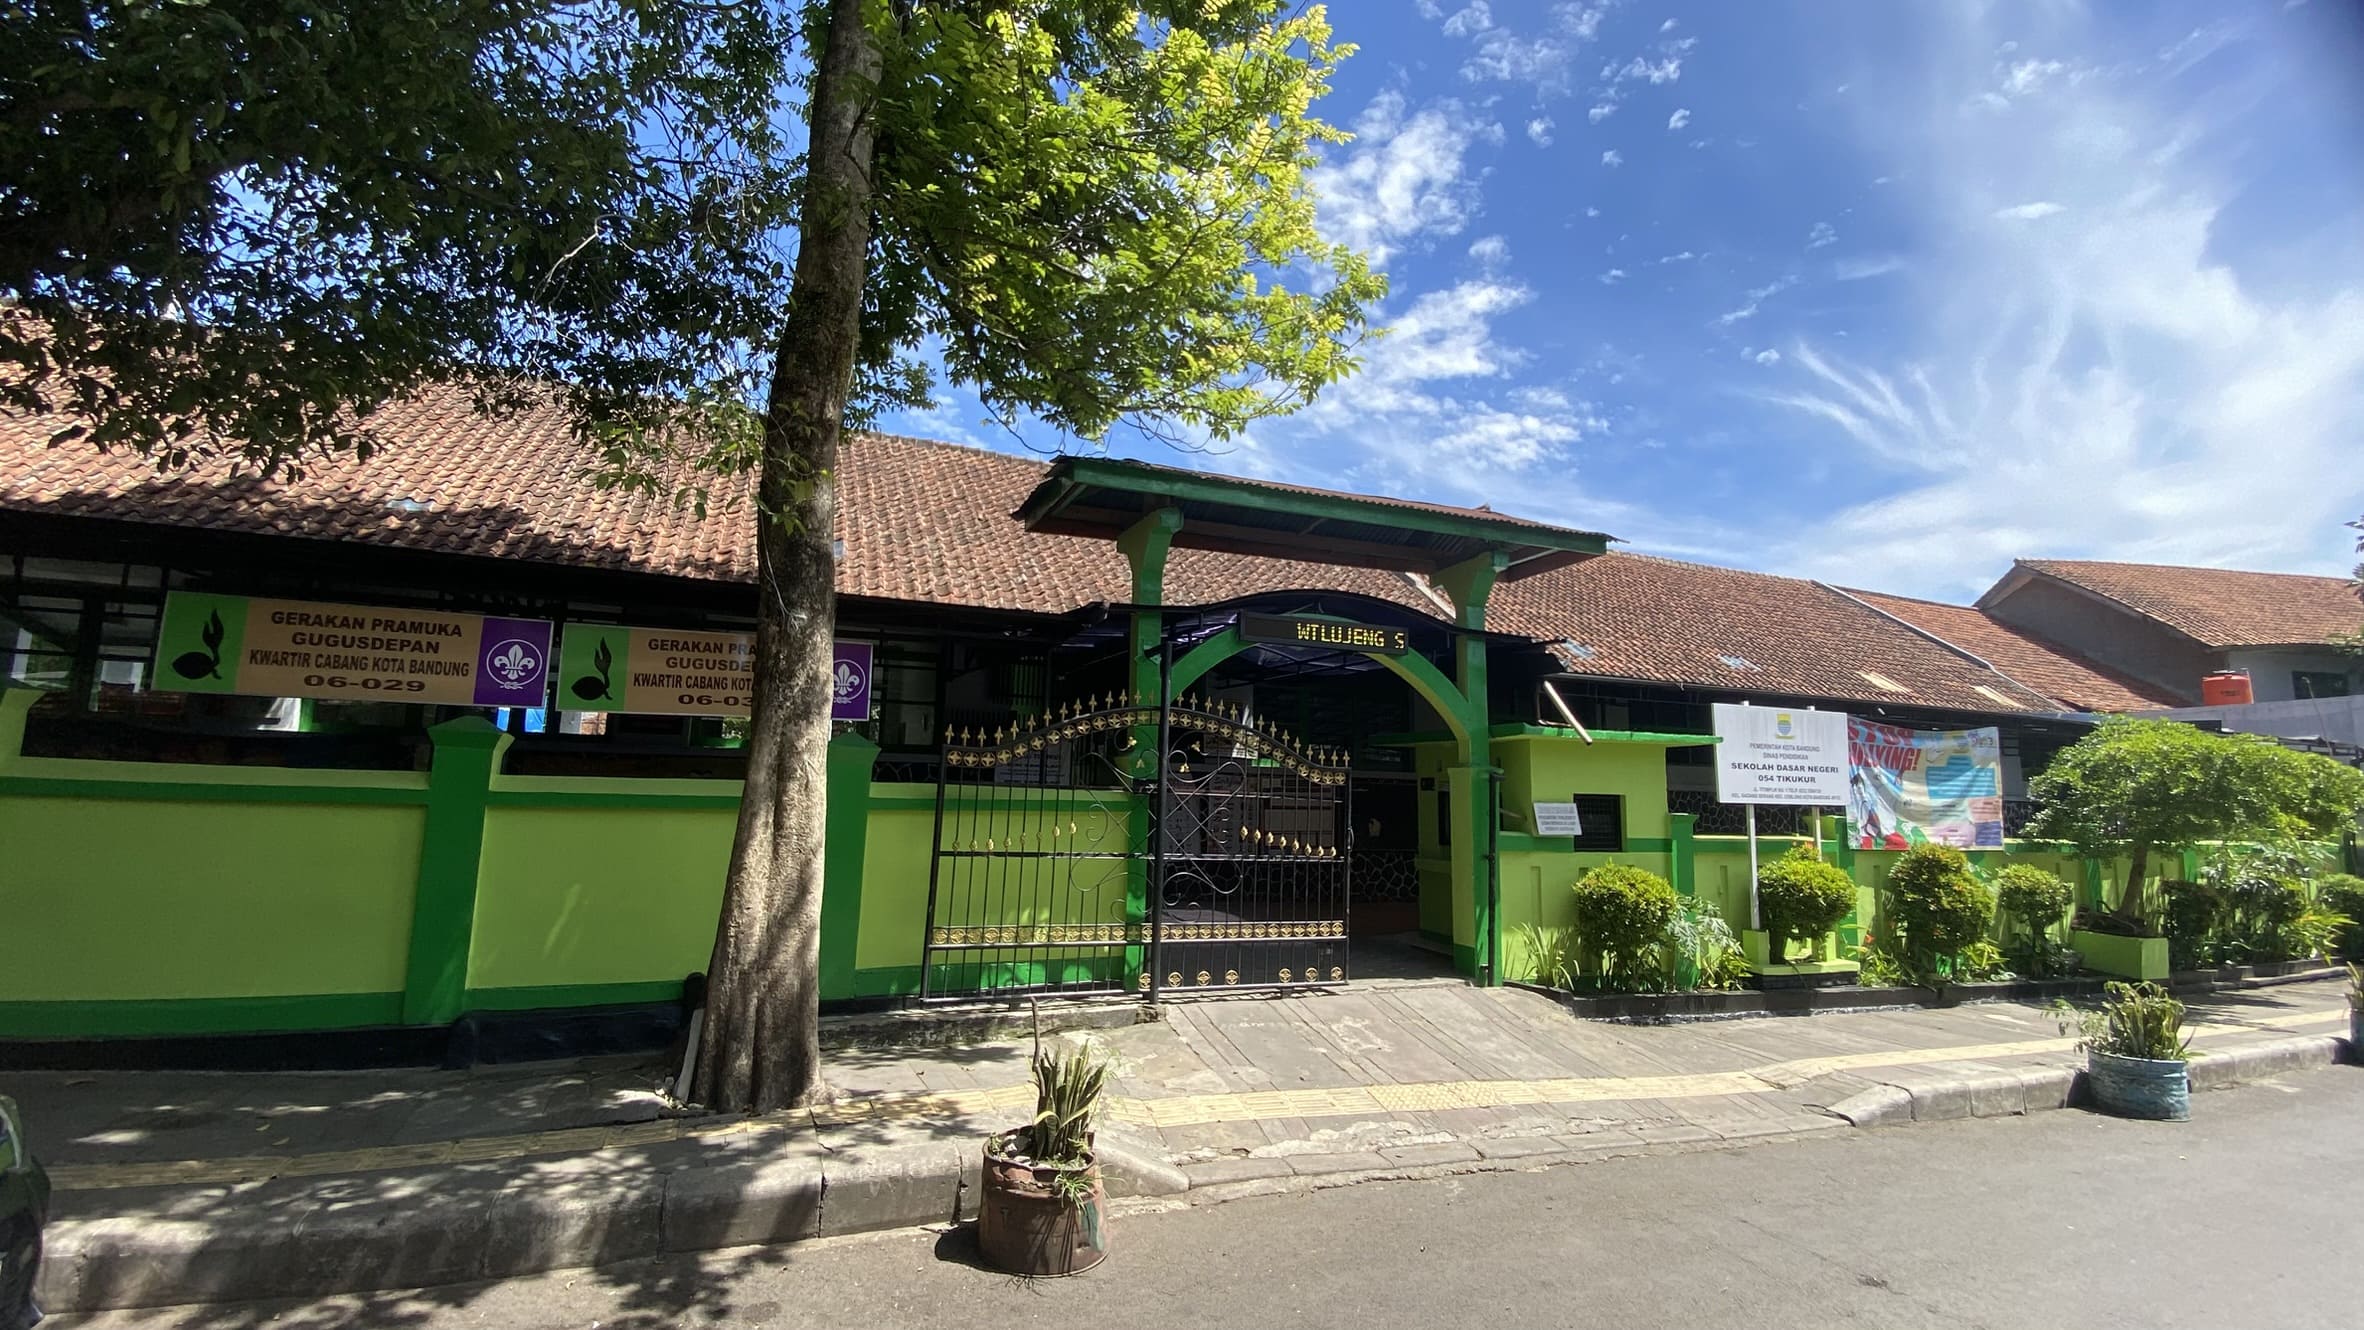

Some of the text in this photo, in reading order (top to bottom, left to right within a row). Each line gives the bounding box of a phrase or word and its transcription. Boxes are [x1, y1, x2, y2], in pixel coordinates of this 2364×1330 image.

[271, 611, 463, 638] GERAKAN PRAMUKA
[291, 632, 439, 654] GUGUSDEPAN
[648, 638, 757, 656] GERAKAN PRA
[249, 649, 469, 677] KWARTIR CABANG KOTA BANDUNG
[666, 656, 755, 673] GUGUSDE
[303, 674, 426, 692] 06-029
[633, 673, 754, 692] KWARTIR CABANG KOT
[678, 694, 753, 707] 06-03
[1731, 762, 1839, 774] SEKOLAH DASAR NEGERI
[1777, 776, 1816, 784] TIKUKUR
